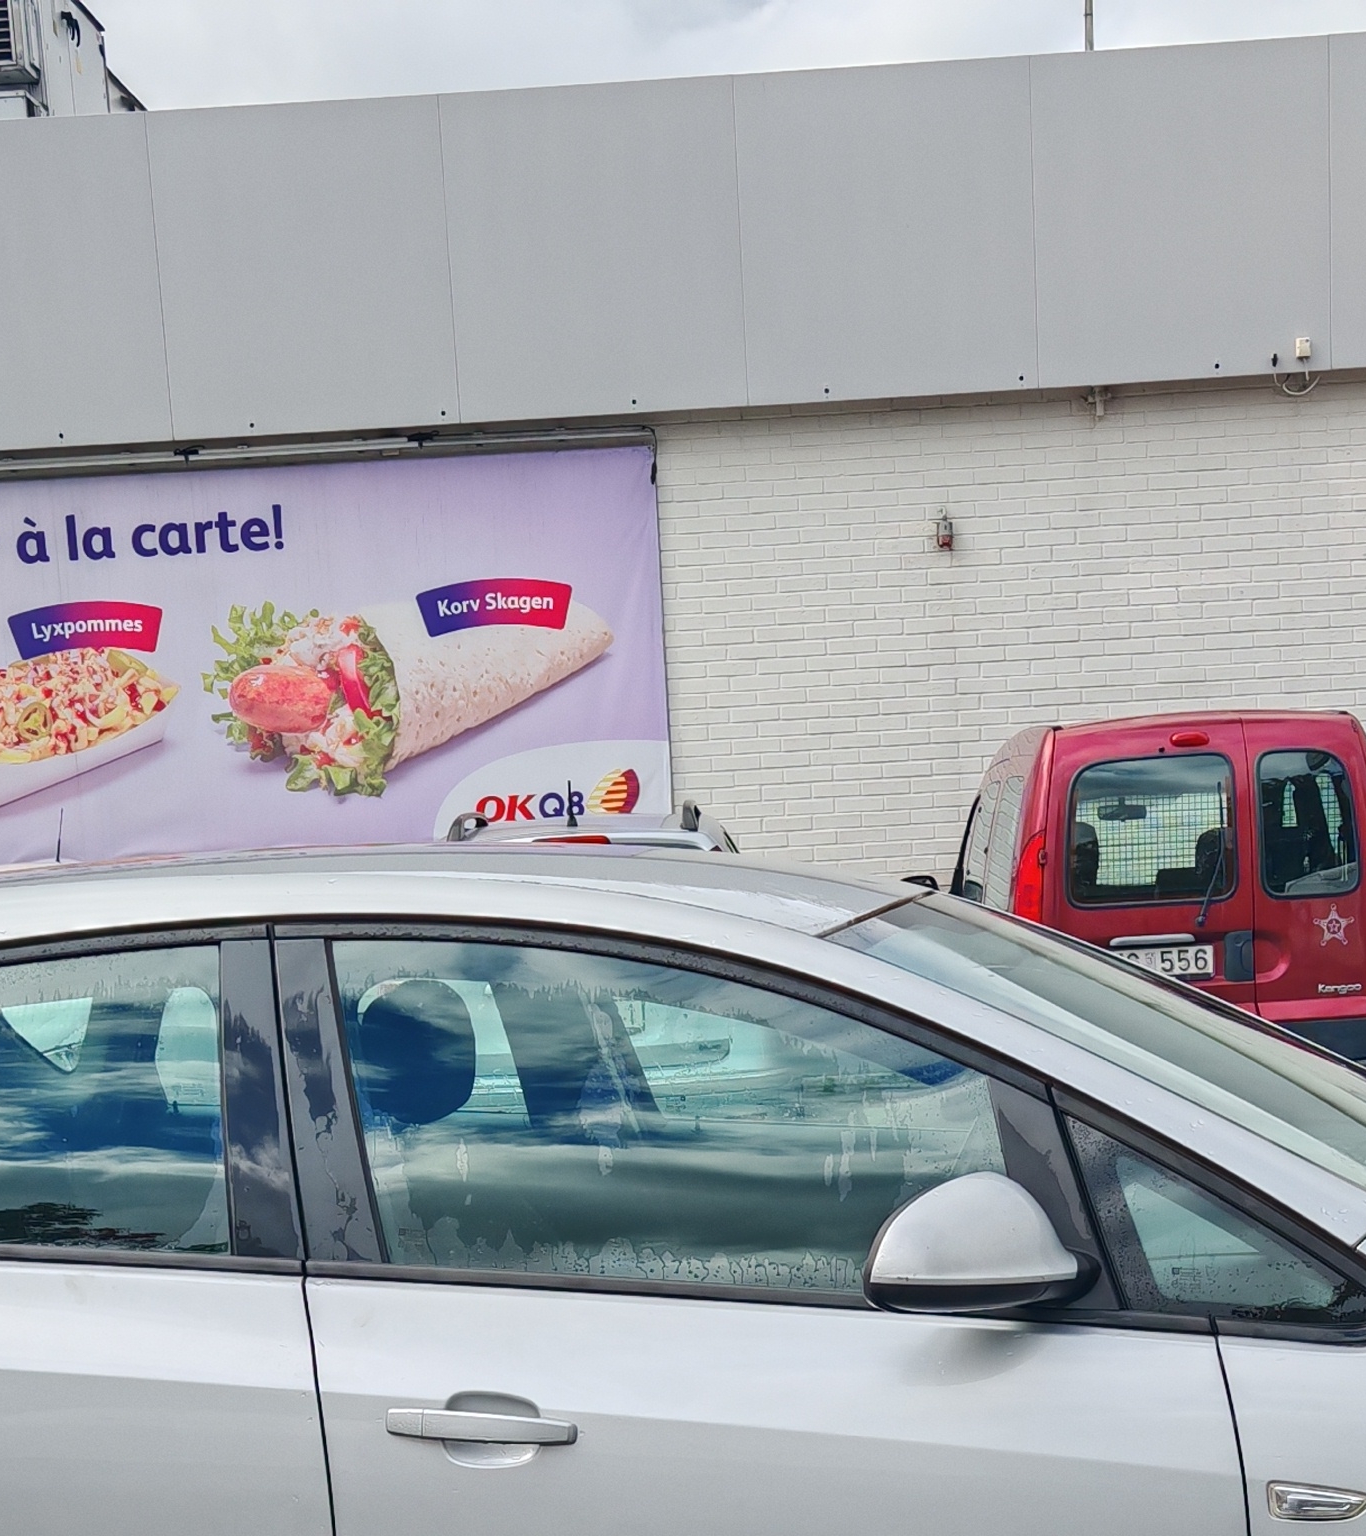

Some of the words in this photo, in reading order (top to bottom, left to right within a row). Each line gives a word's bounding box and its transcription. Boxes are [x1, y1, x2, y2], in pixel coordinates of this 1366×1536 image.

[16, 517, 50, 564] à
[66, 513, 115, 561] la
[131, 503, 286, 559] carte!
[436, 595, 483, 618] Korv
[485, 591, 555, 616] Skagen
[31, 614, 144, 642] Lyxpommes
[1160, 948, 1209, 973] 556
[1317, 982, 1363, 996] Kangoo
